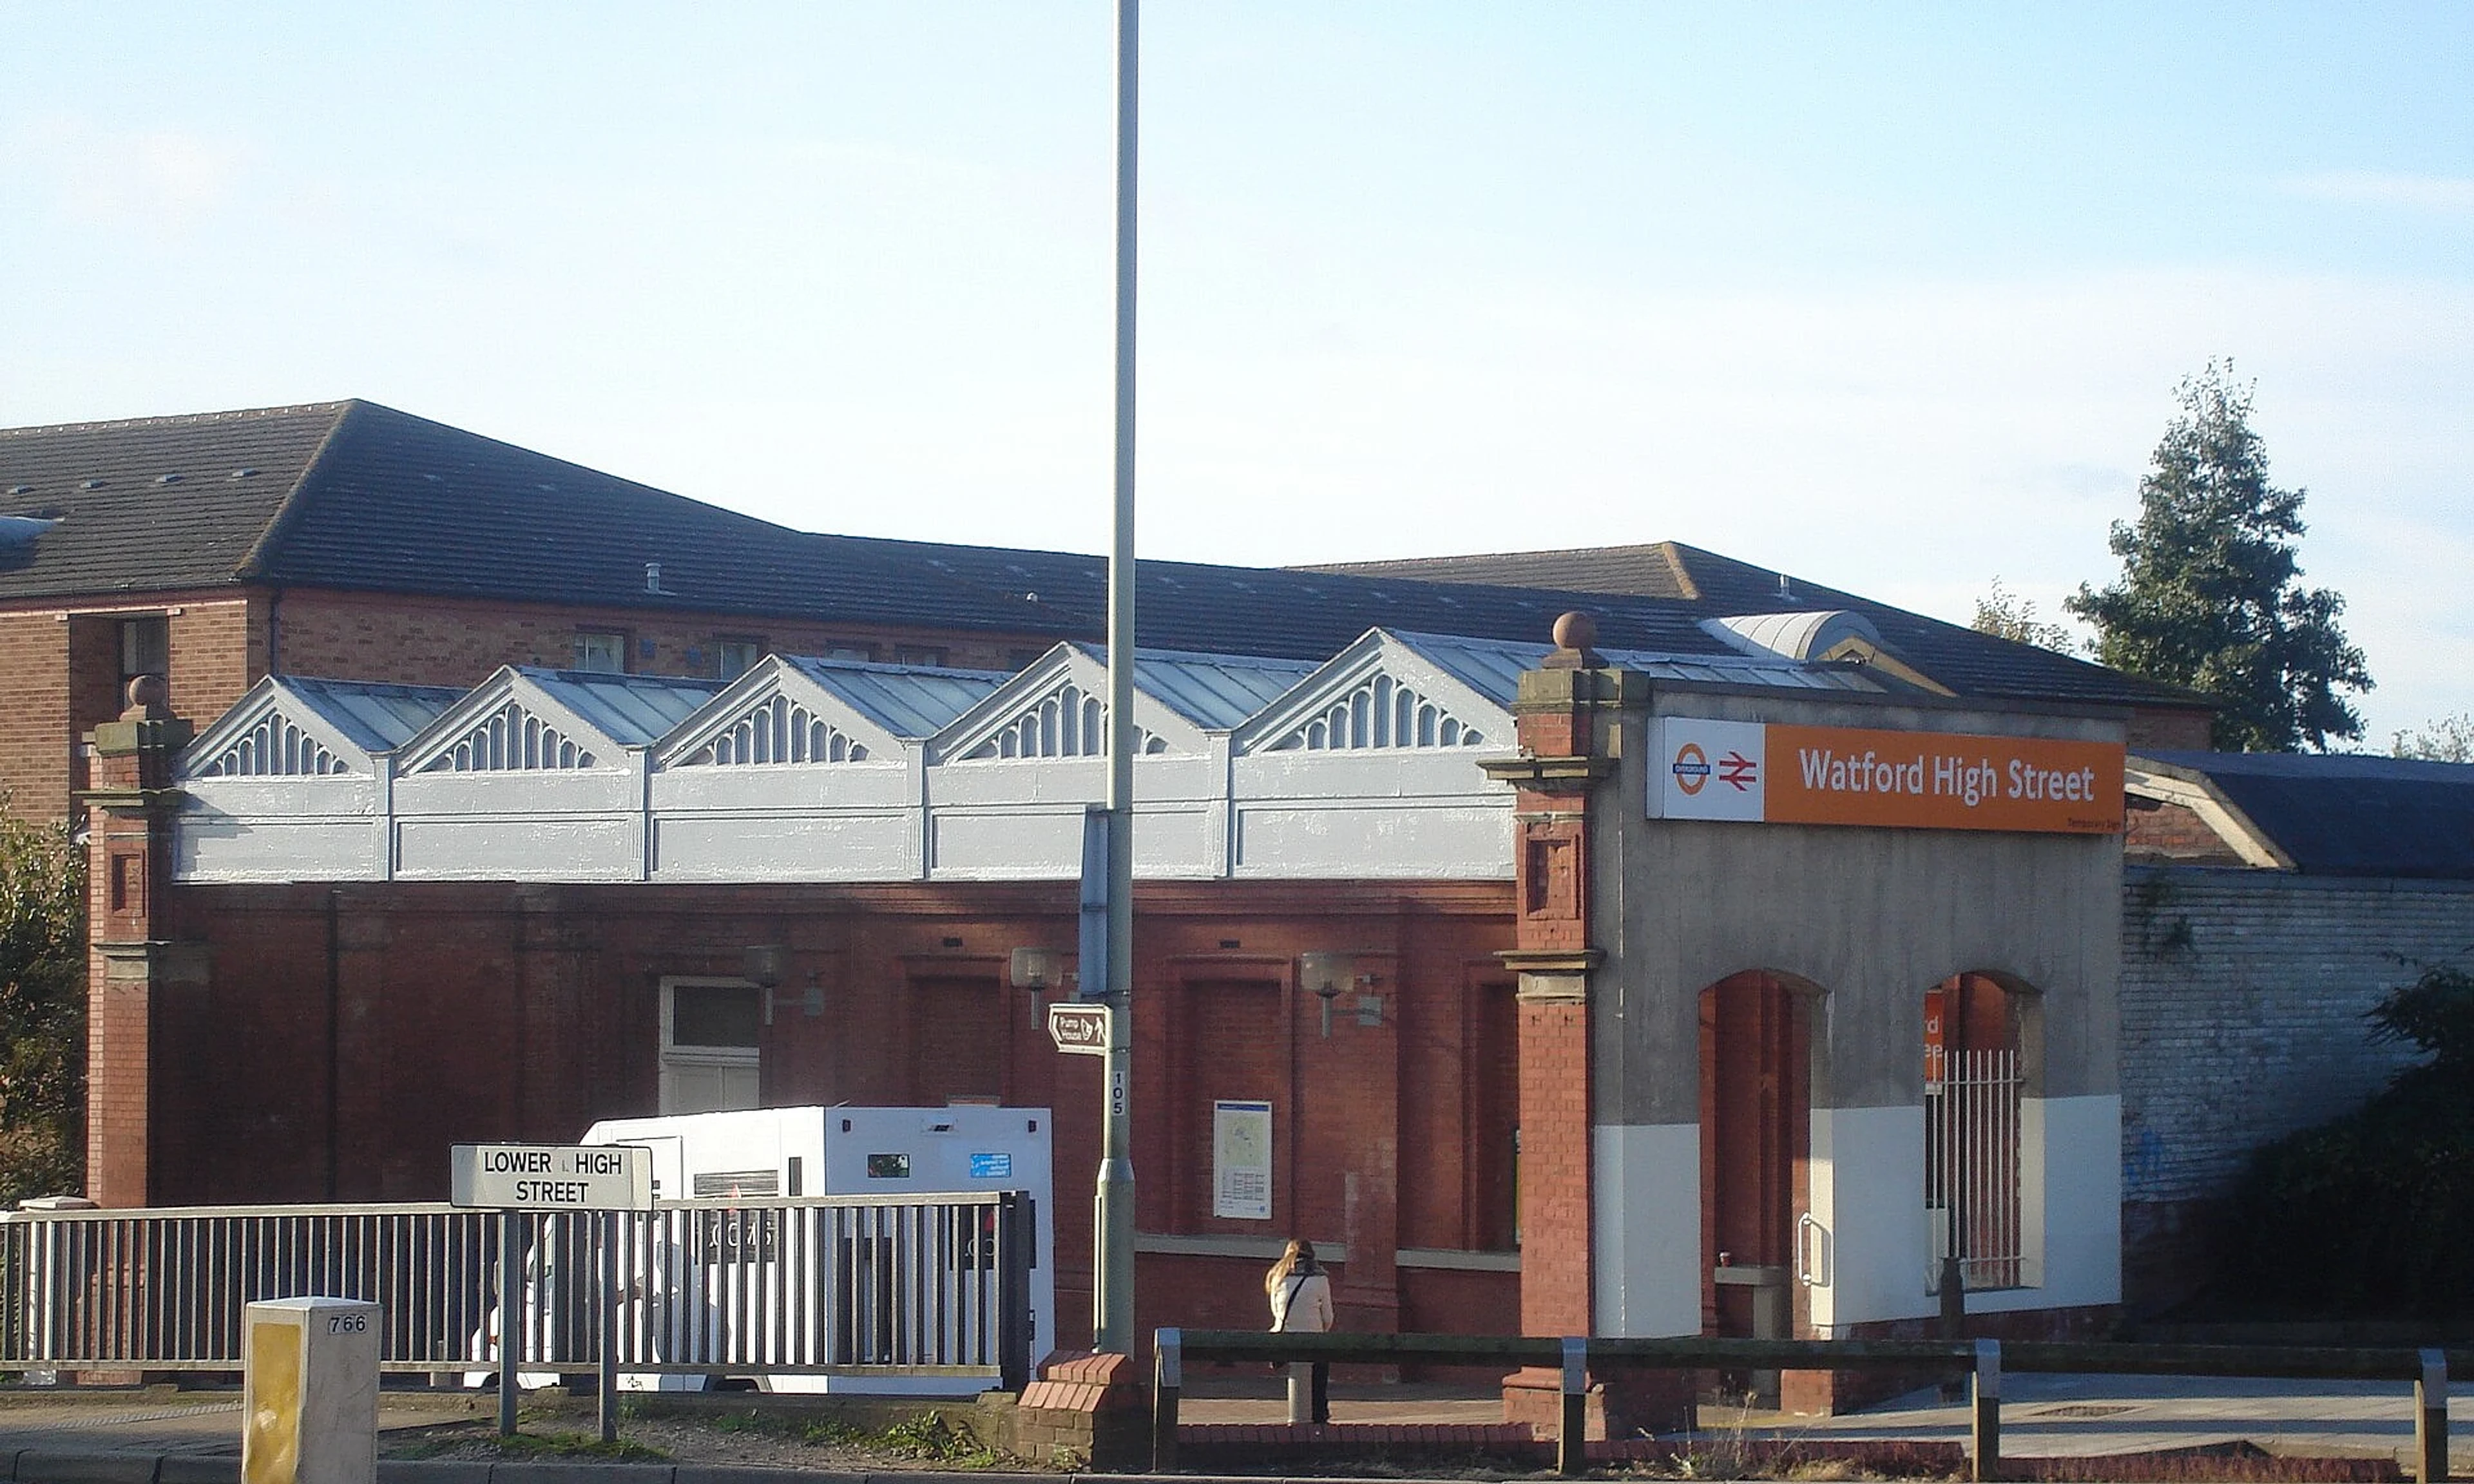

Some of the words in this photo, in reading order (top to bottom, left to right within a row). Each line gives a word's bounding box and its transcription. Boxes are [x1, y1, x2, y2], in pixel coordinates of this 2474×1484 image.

[1799, 748, 1922, 794] Watford
[1933, 756, 1997, 806] High
[2008, 759, 2095, 801] Street
[484, 1152, 551, 1173] LOWER
[575, 1154, 622, 1174] HIGH
[516, 1181, 590, 1203] STREET
[330, 1315, 366, 1333] 766
